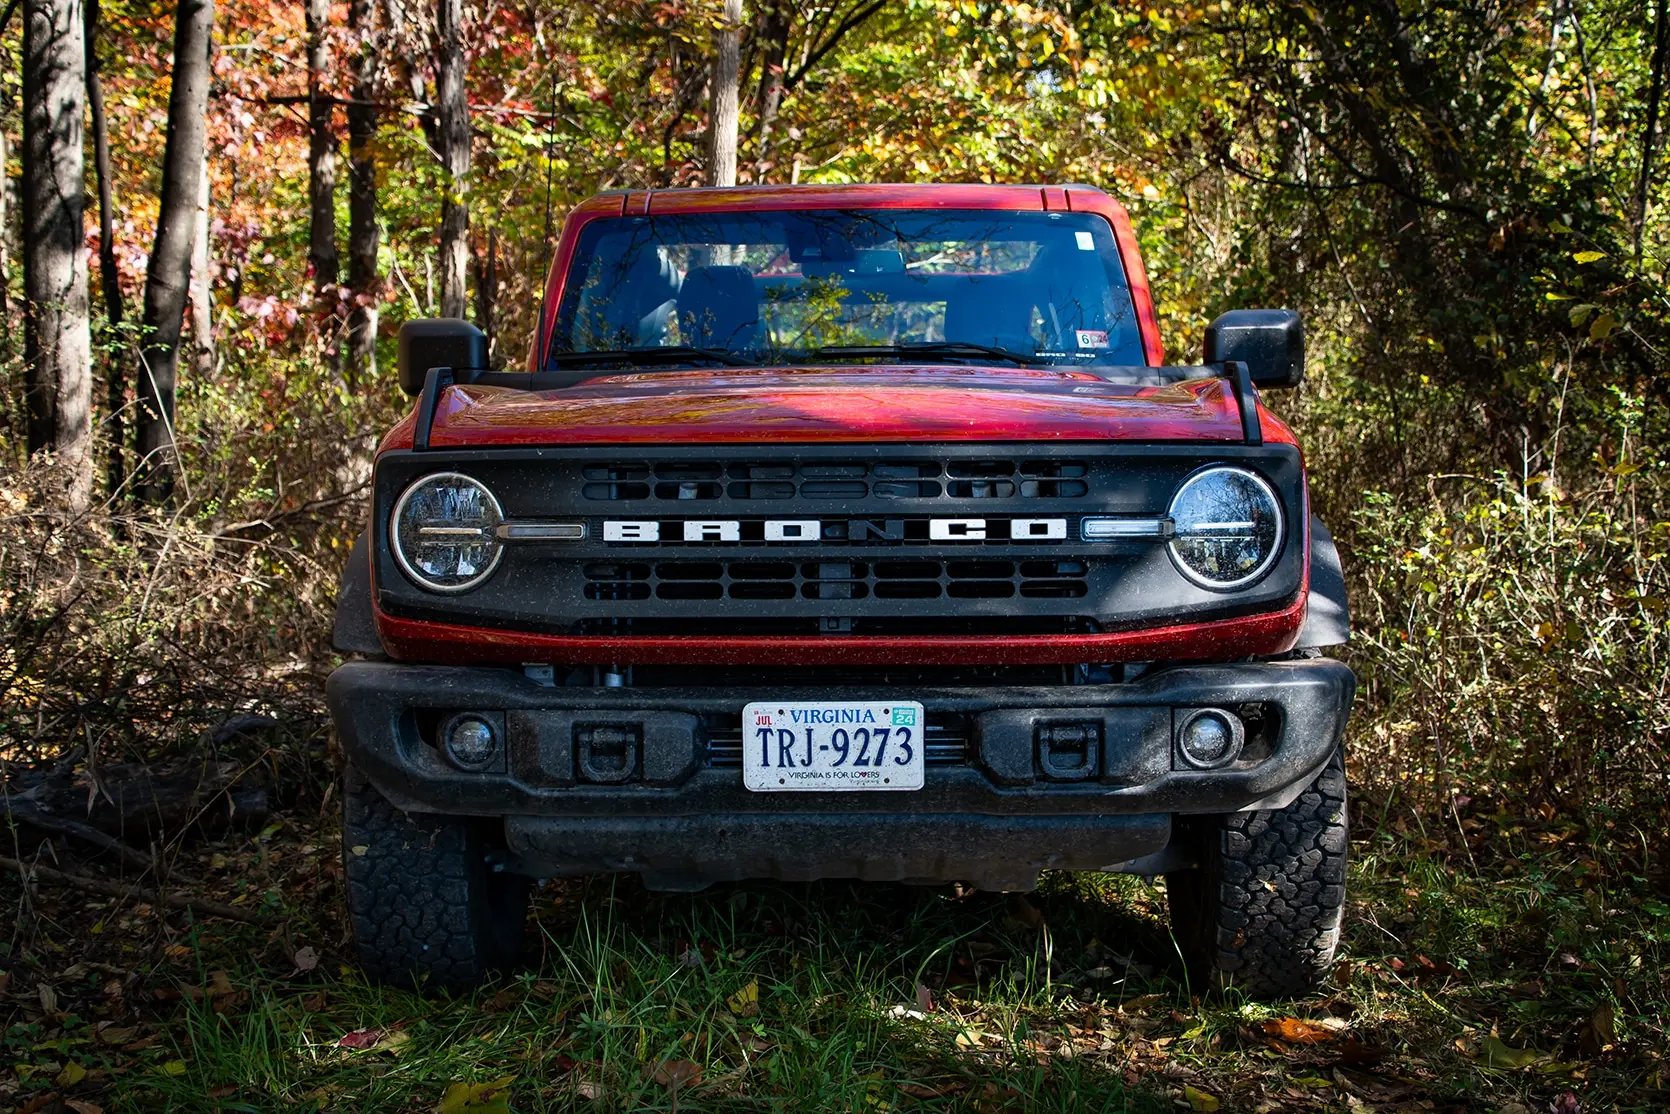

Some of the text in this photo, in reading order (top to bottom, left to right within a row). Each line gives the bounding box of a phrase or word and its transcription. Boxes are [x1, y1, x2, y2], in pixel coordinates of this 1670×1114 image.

[1081, 334, 1090, 345] 6
[602, 518, 1067, 542] BRONCO
[755, 715, 772, 726] JUL
[790, 709, 875, 724] VIRGINIA
[895, 714, 913, 725] 24
[755, 727, 913, 768] TRJ-9273
